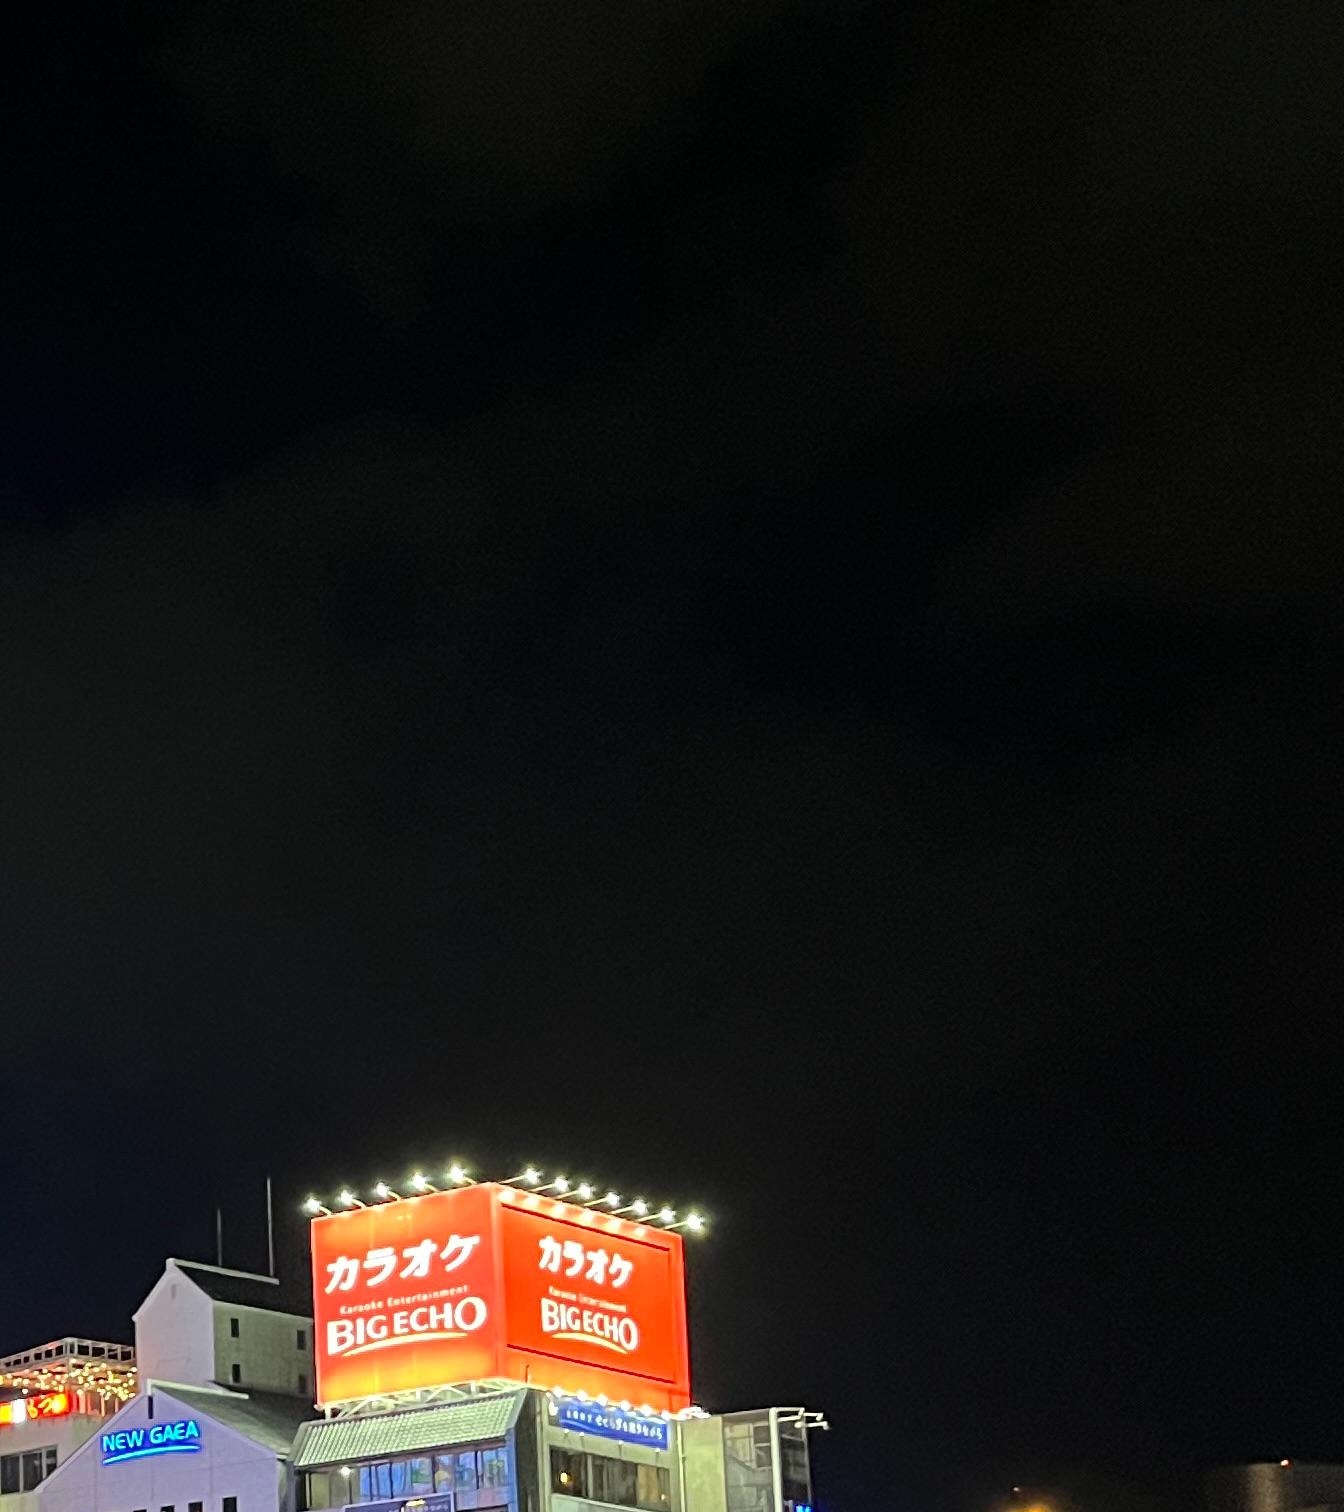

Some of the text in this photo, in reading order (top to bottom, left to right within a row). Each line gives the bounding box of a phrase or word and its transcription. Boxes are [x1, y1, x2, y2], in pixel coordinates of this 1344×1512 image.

[324, 1234, 481, 1294] カラオケ
[538, 1235, 633, 1288] カラオケ
[326, 1296, 488, 1355] BIG ECHO
[540, 1297, 581, 1332] BIG
[582, 1310, 639, 1351] ECHO
[102, 1420, 198, 1452] NEW GAEA
